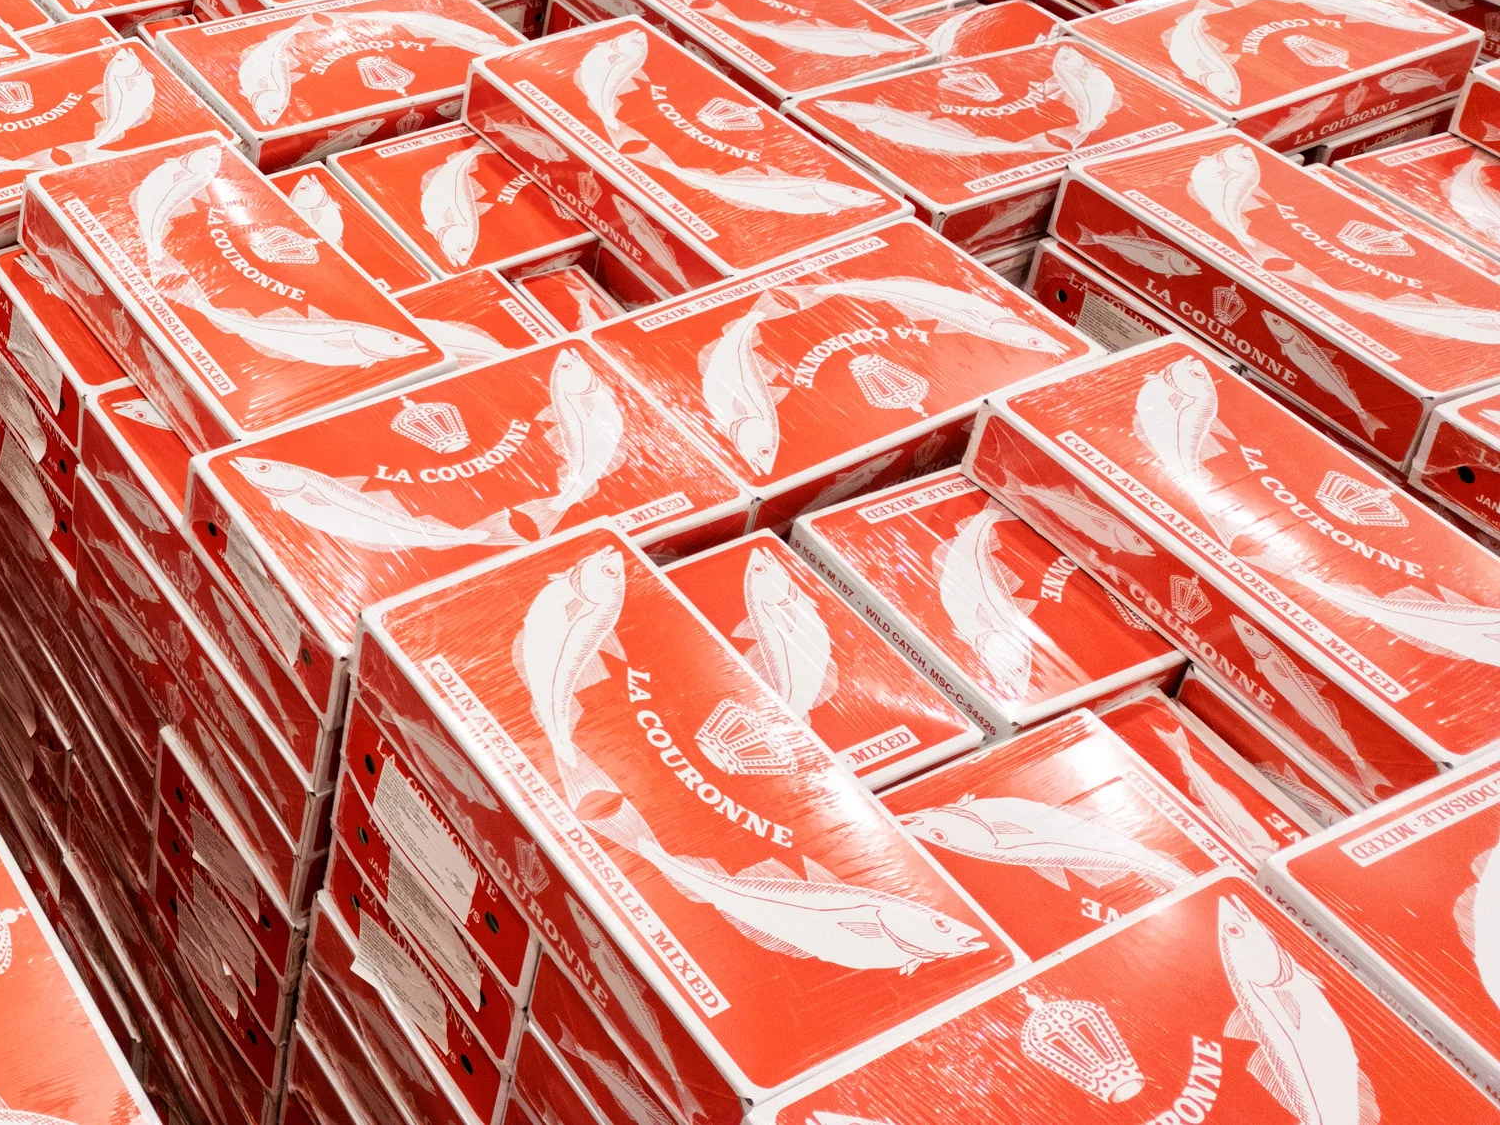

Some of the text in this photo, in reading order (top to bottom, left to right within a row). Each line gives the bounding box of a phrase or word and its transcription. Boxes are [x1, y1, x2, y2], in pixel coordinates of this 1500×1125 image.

[310, 41, 394, 75] COURONNE
[1242, 17, 1343, 55] LA COURONNE
[380, 137, 423, 156] MIXED
[519, 81, 714, 239] COLIN AVEC DORSALE MIXED
[650, 83, 761, 163] LA COURONNE
[1137, 123, 1180, 141] MIXED
[1294, 99, 1399, 147] LA COURONNE
[208, 207, 306, 301] LA COURONNE
[532, 163, 643, 263] LA COURONNE
[1276, 203, 1424, 291] LA COURONNE
[146, 295, 231, 391] DORSALE MIXED
[641, 281, 758, 330] DORSALE MIXED
[1145, 277, 1299, 387] LA COURONNE
[1259, 273, 1393, 360] DORSALE MIXED
[794, 325, 931, 388] LA COURONNE
[376, 419, 532, 484] LA COURONNE
[629, 495, 687, 522] MIXED
[1239, 445, 1425, 581] LA COURONNE
[1064, 435, 1117, 477] COLIN
[1118, 477, 1164, 517] AVEC
[1227, 557, 1323, 638] DORSALE
[1325, 635, 1402, 698] MIXED
[802, 547, 816, 564] KG
[818, 562, 826, 573] K
[826, 571, 855, 597] M.157
[865, 605, 891, 634] WILD
[892, 631, 928, 672] CATCH,
[929, 668, 998, 737] MSC-C-54426
[1128, 585, 1277, 709] COURONNE
[627, 665, 794, 851] LA COURONNE
[850, 729, 912, 767] MIXED
[430, 660, 721, 1011] COLIN AVEC DORSALE MIXED
[1350, 821, 1406, 860] MIXED
[486, 838, 608, 1009] COURONNE
